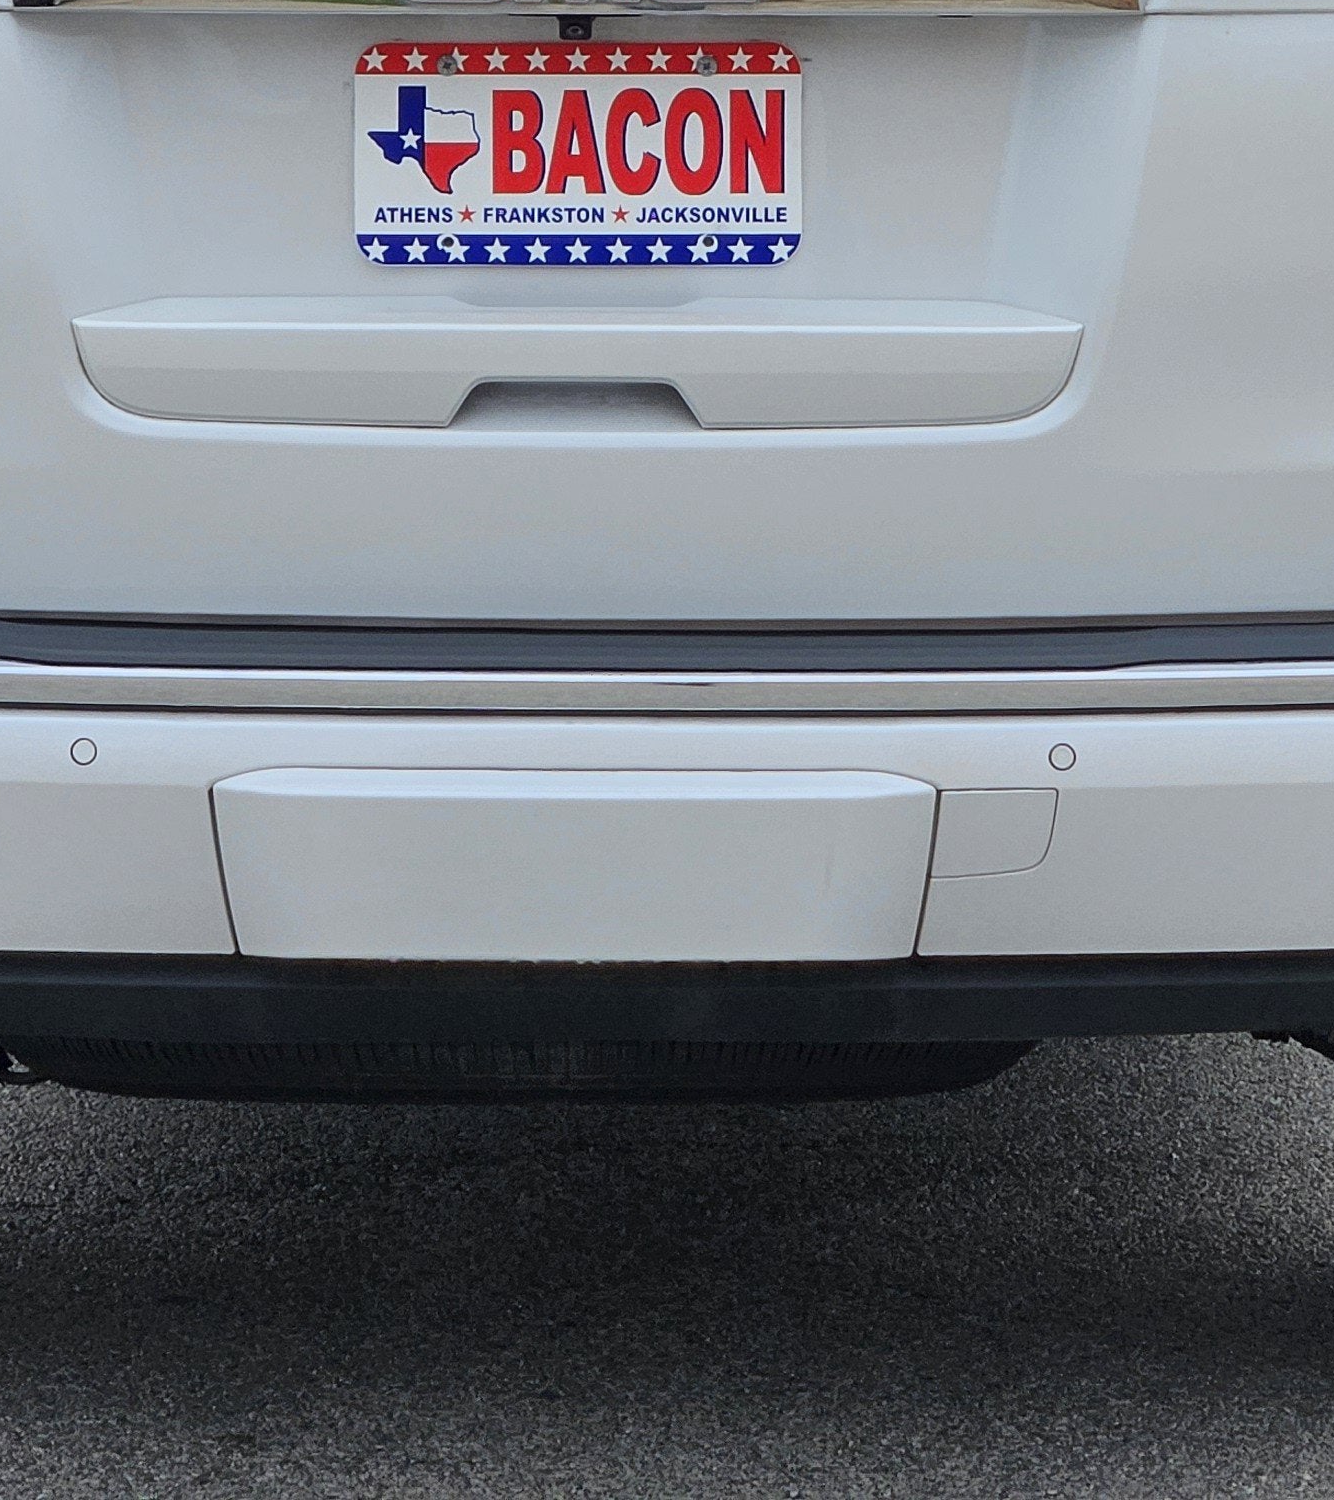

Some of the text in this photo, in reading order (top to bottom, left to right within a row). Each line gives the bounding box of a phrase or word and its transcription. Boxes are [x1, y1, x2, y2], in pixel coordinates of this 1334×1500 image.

[490, 87, 787, 196] BACON
[374, 206, 788, 225] ATHENS FRANKSTON JACKSONVILLE
